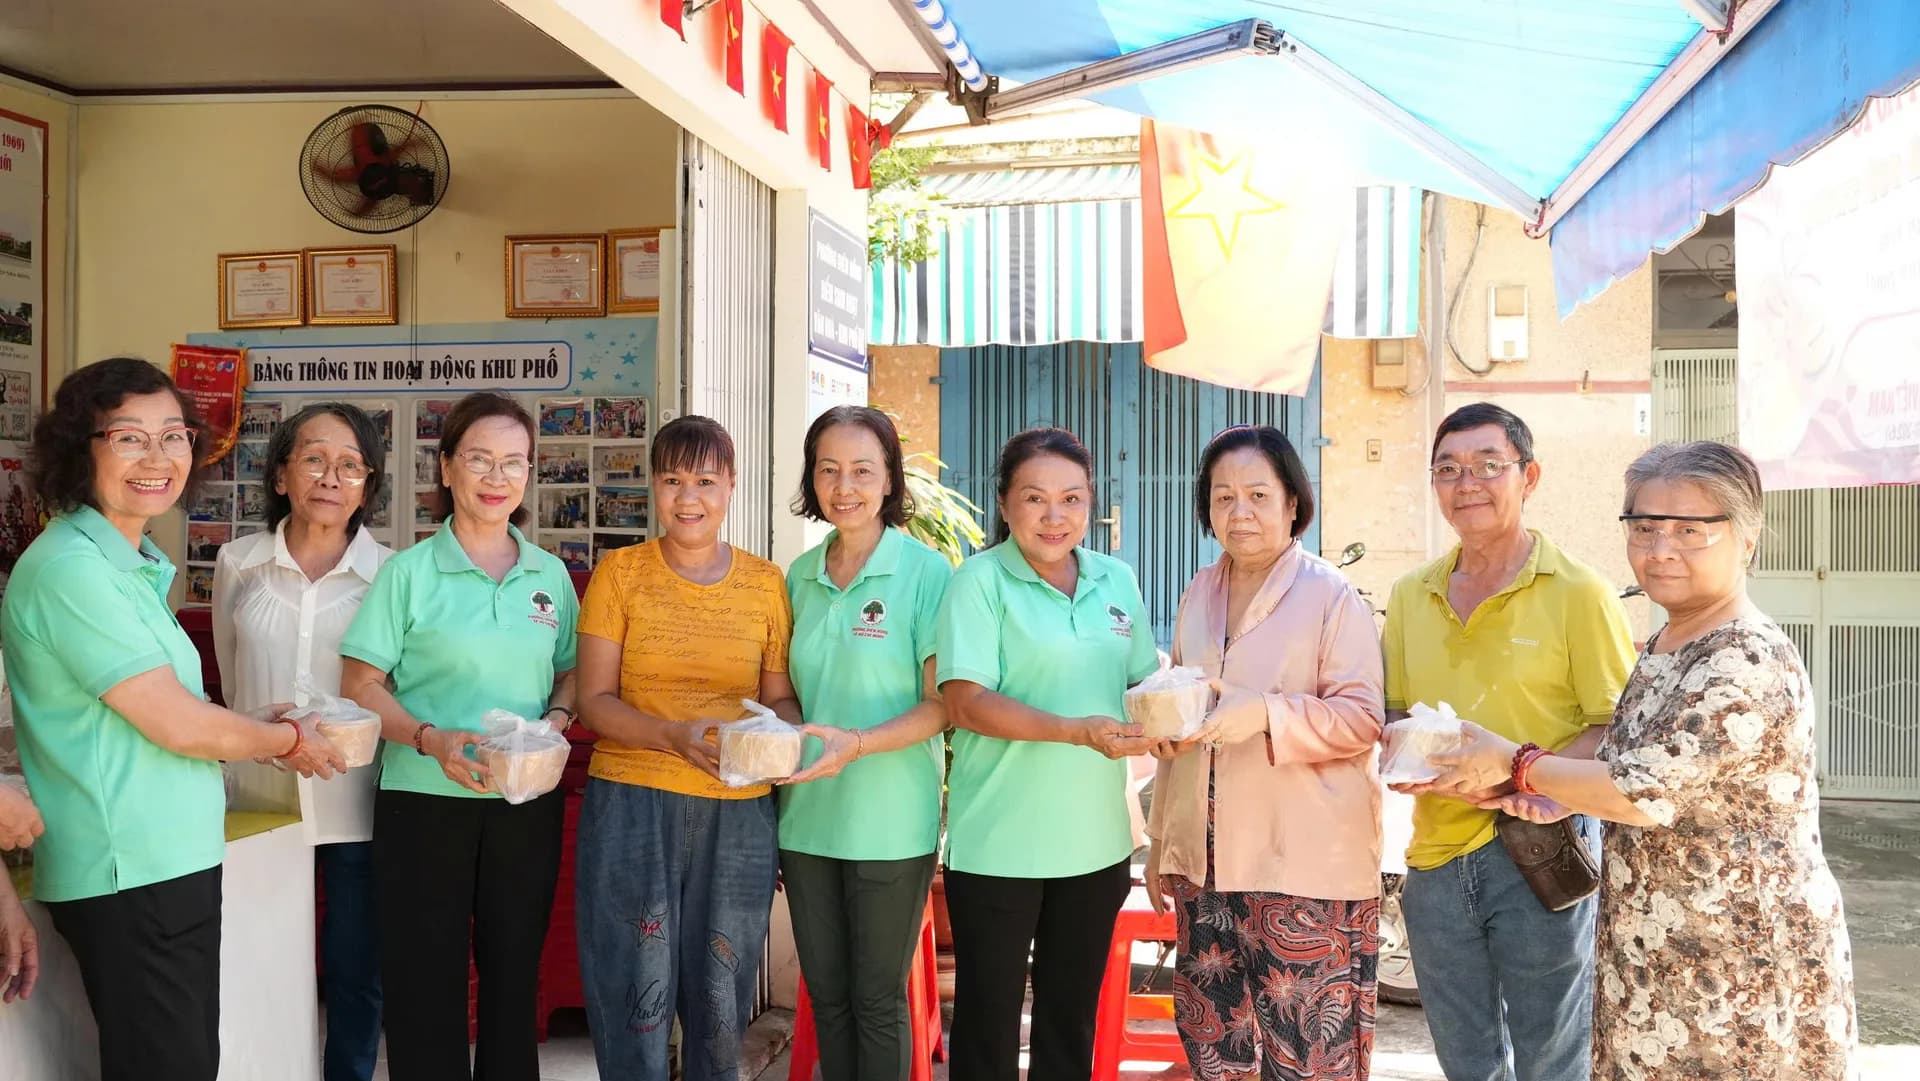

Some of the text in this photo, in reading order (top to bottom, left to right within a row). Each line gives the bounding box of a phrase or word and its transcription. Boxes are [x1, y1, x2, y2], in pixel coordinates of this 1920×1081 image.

[253, 347, 558, 386] BẢNG THÔNG TIN HOẠT ĐỘNG KHU PHỐ
